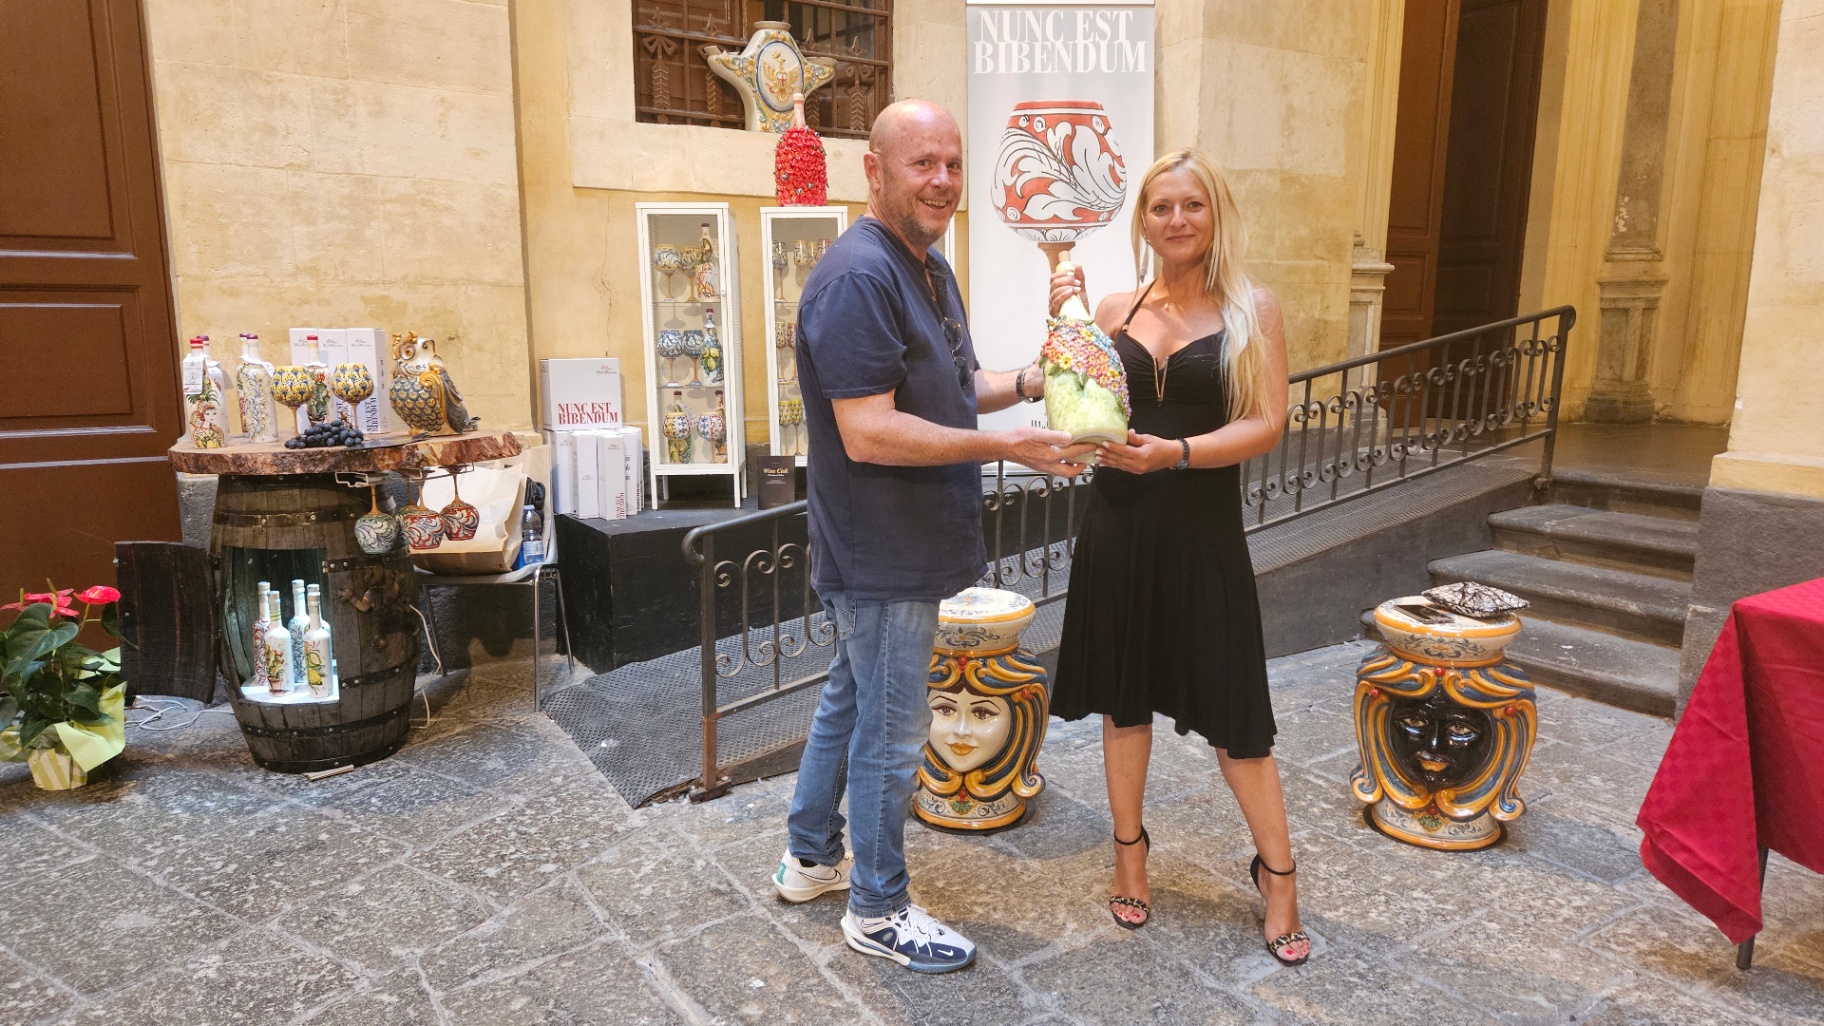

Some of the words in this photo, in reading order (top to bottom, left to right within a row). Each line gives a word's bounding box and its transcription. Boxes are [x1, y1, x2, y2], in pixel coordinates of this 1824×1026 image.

[979, 10, 1064, 43] NUNC
[1074, 10, 1133, 43] EST
[973, 41, 1147, 74] BIBENDUM
[558, 403, 588, 414] NUNC
[591, 402, 612, 413] EST
[558, 412, 618, 425] BIBENDUM
